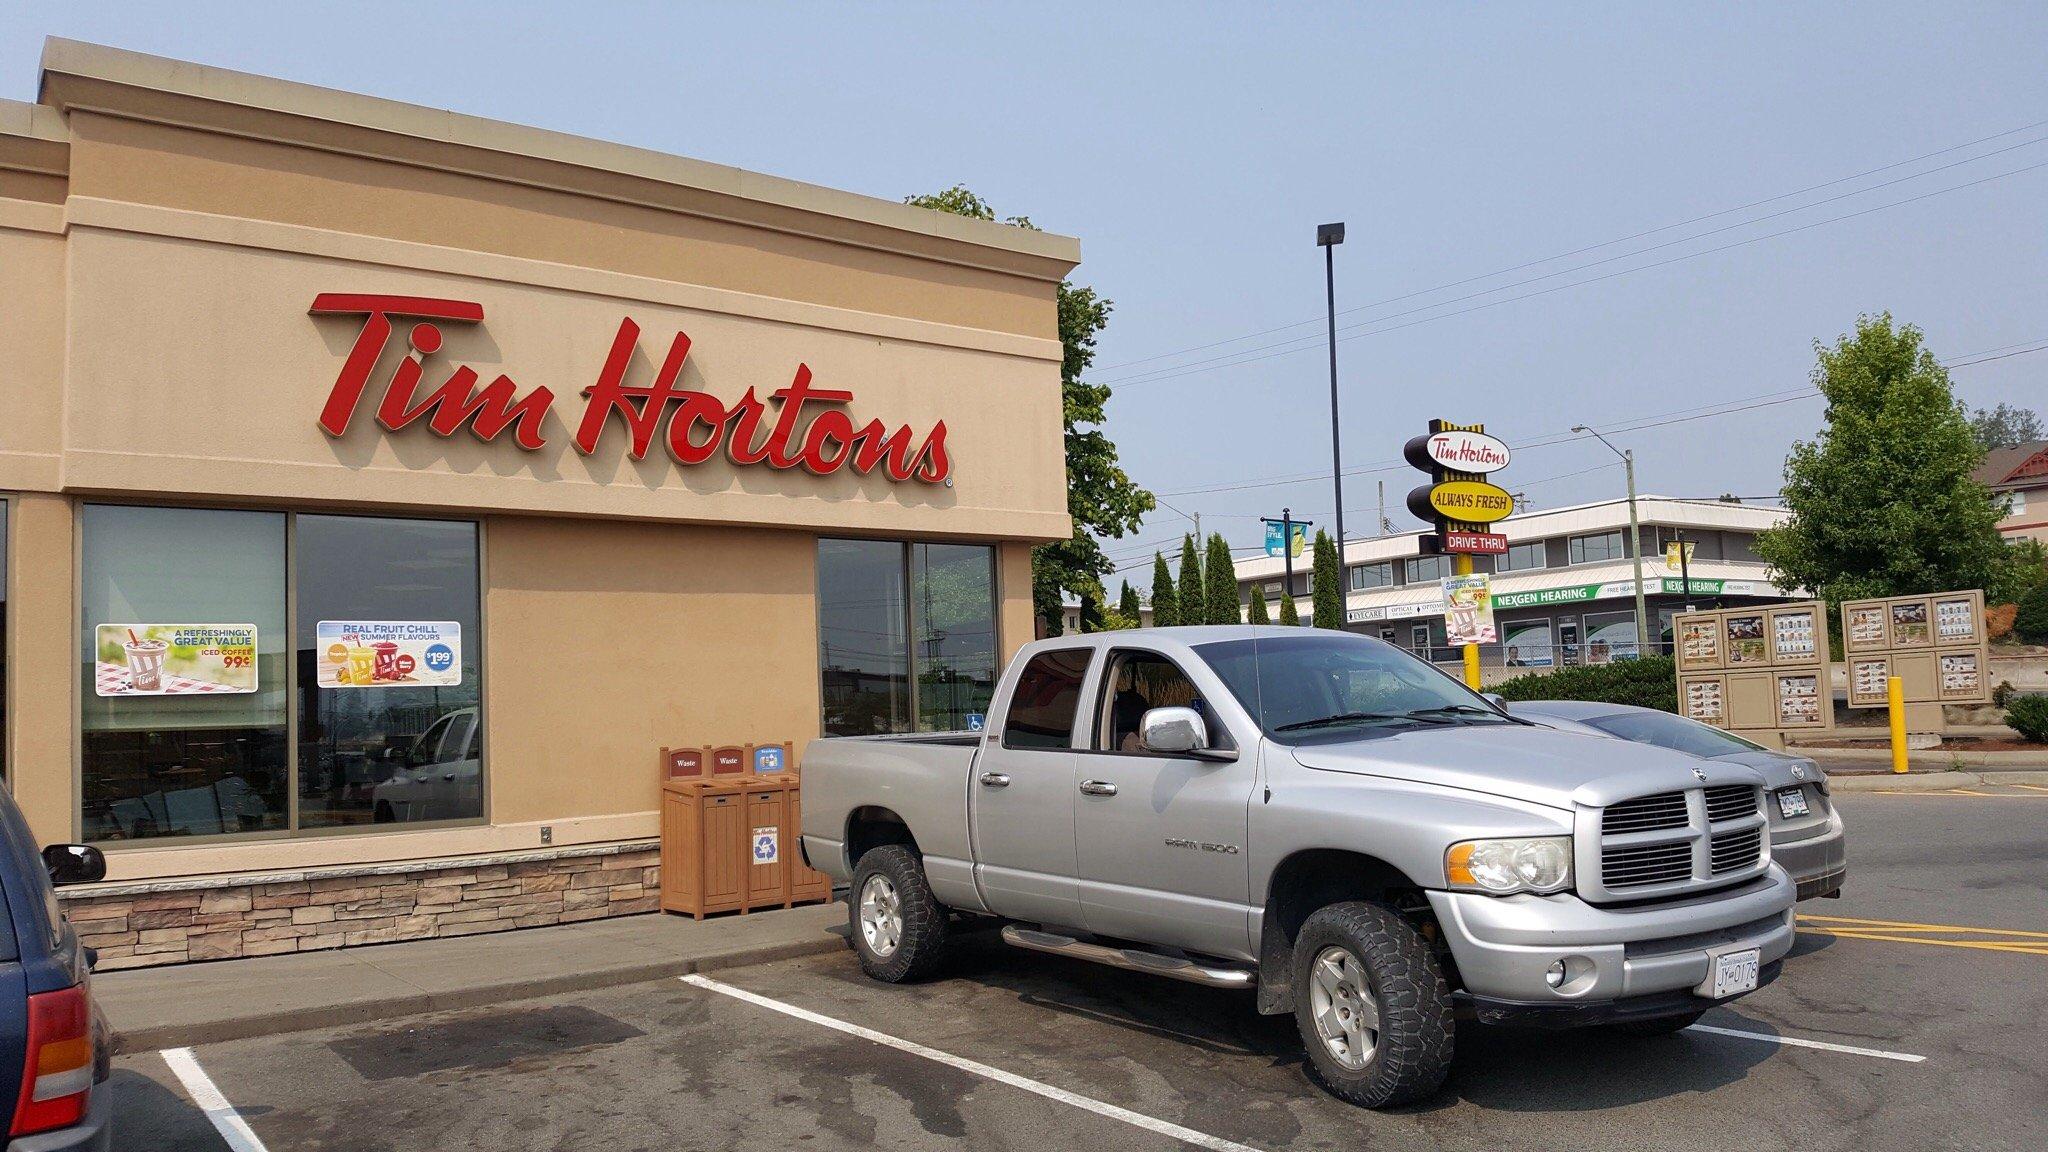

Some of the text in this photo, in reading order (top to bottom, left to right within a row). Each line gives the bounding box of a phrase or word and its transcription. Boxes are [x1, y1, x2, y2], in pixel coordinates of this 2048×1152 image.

[308, 292, 950, 484] Tim Hortons
[1433, 437, 1506, 465] Tim Hortons
[1434, 492, 1508, 510] ALWAYS FRESH
[1448, 536, 1505, 550] DRIVE THRU
[1666, 580, 1720, 593] NEXGN HEARING
[1497, 587, 1587, 606] NEXGEN HEARING
[1353, 611, 1384, 621] EYECARE
[184, 629, 252, 637] REFRESHINGLY
[343, 625, 437, 634] REAL FRUIT CHILL
[174, 637, 252, 646] GREAT VALUE
[720, 757, 738, 765] Waste
